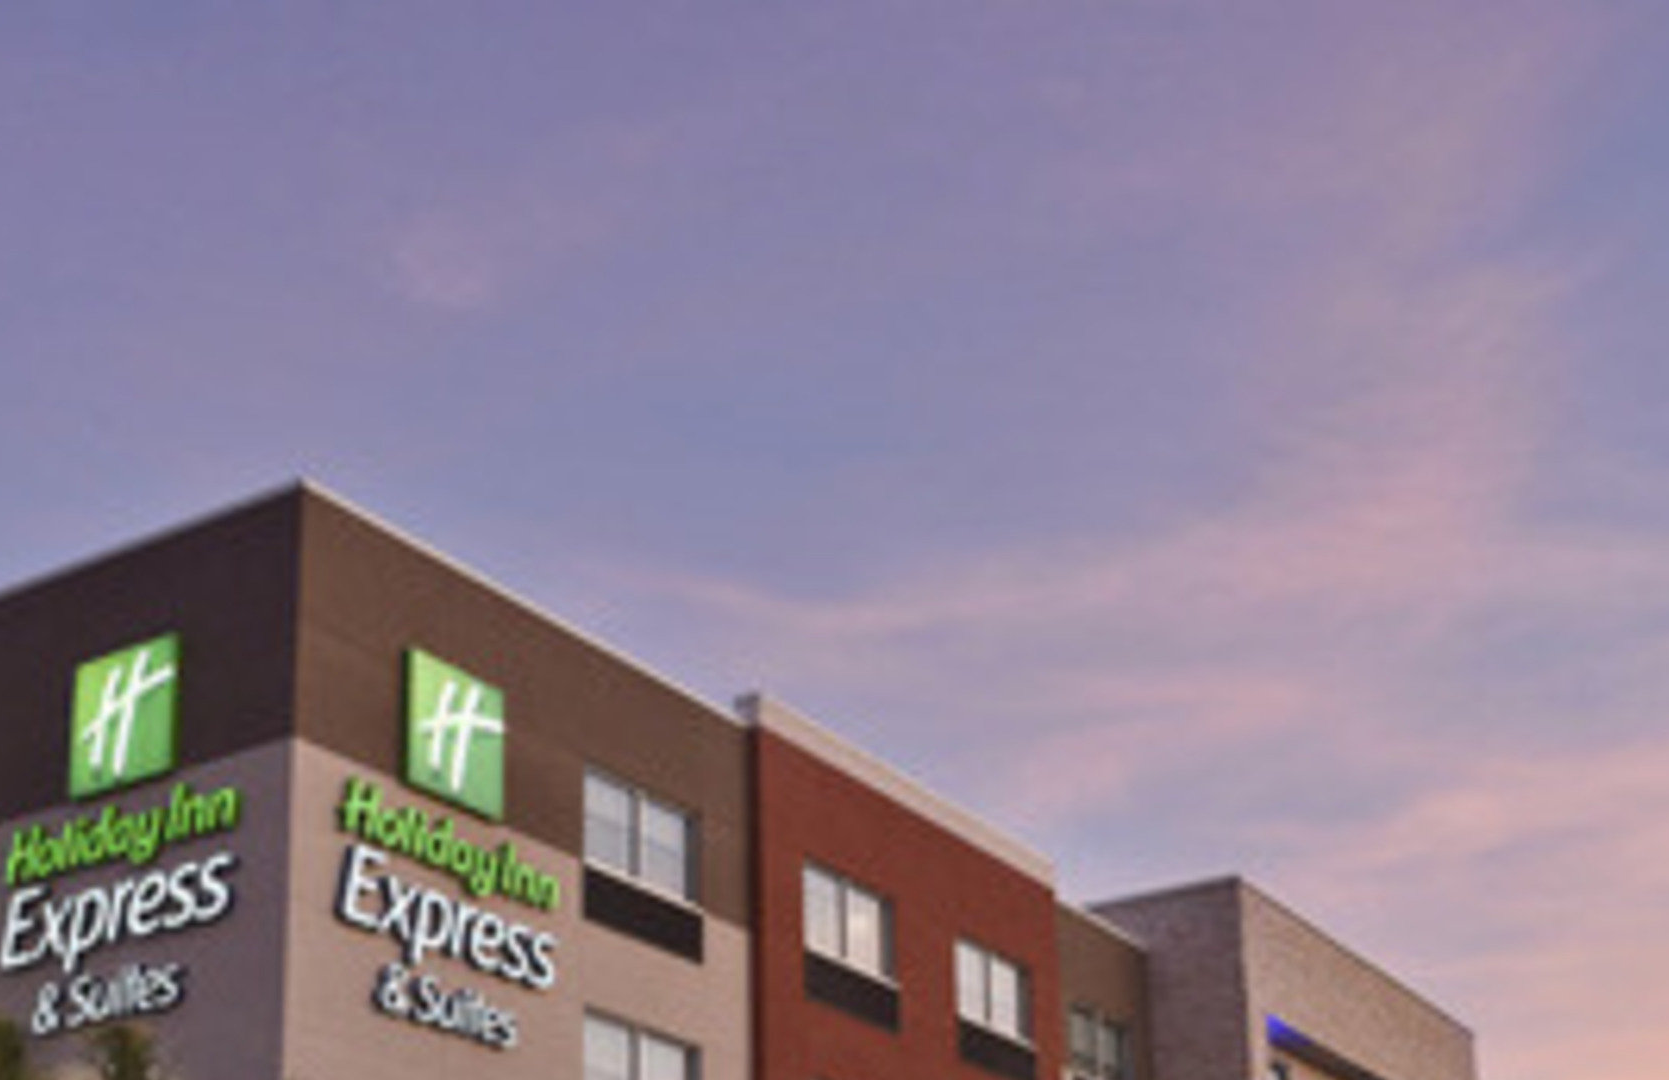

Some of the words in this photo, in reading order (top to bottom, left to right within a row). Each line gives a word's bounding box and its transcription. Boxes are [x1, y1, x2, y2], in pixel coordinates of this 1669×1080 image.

[5, 803, 163, 886] Holiday
[164, 783, 238, 841] Inn
[340, 776, 499, 897] Holiday
[498, 841, 560, 910] Inn
[0, 852, 234, 973] Express
[340, 844, 558, 990] Express
[32, 981, 60, 1035] &
[65, 963, 182, 1028] Suites
[377, 961, 408, 1013] &
[414, 974, 519, 1049] Suites
